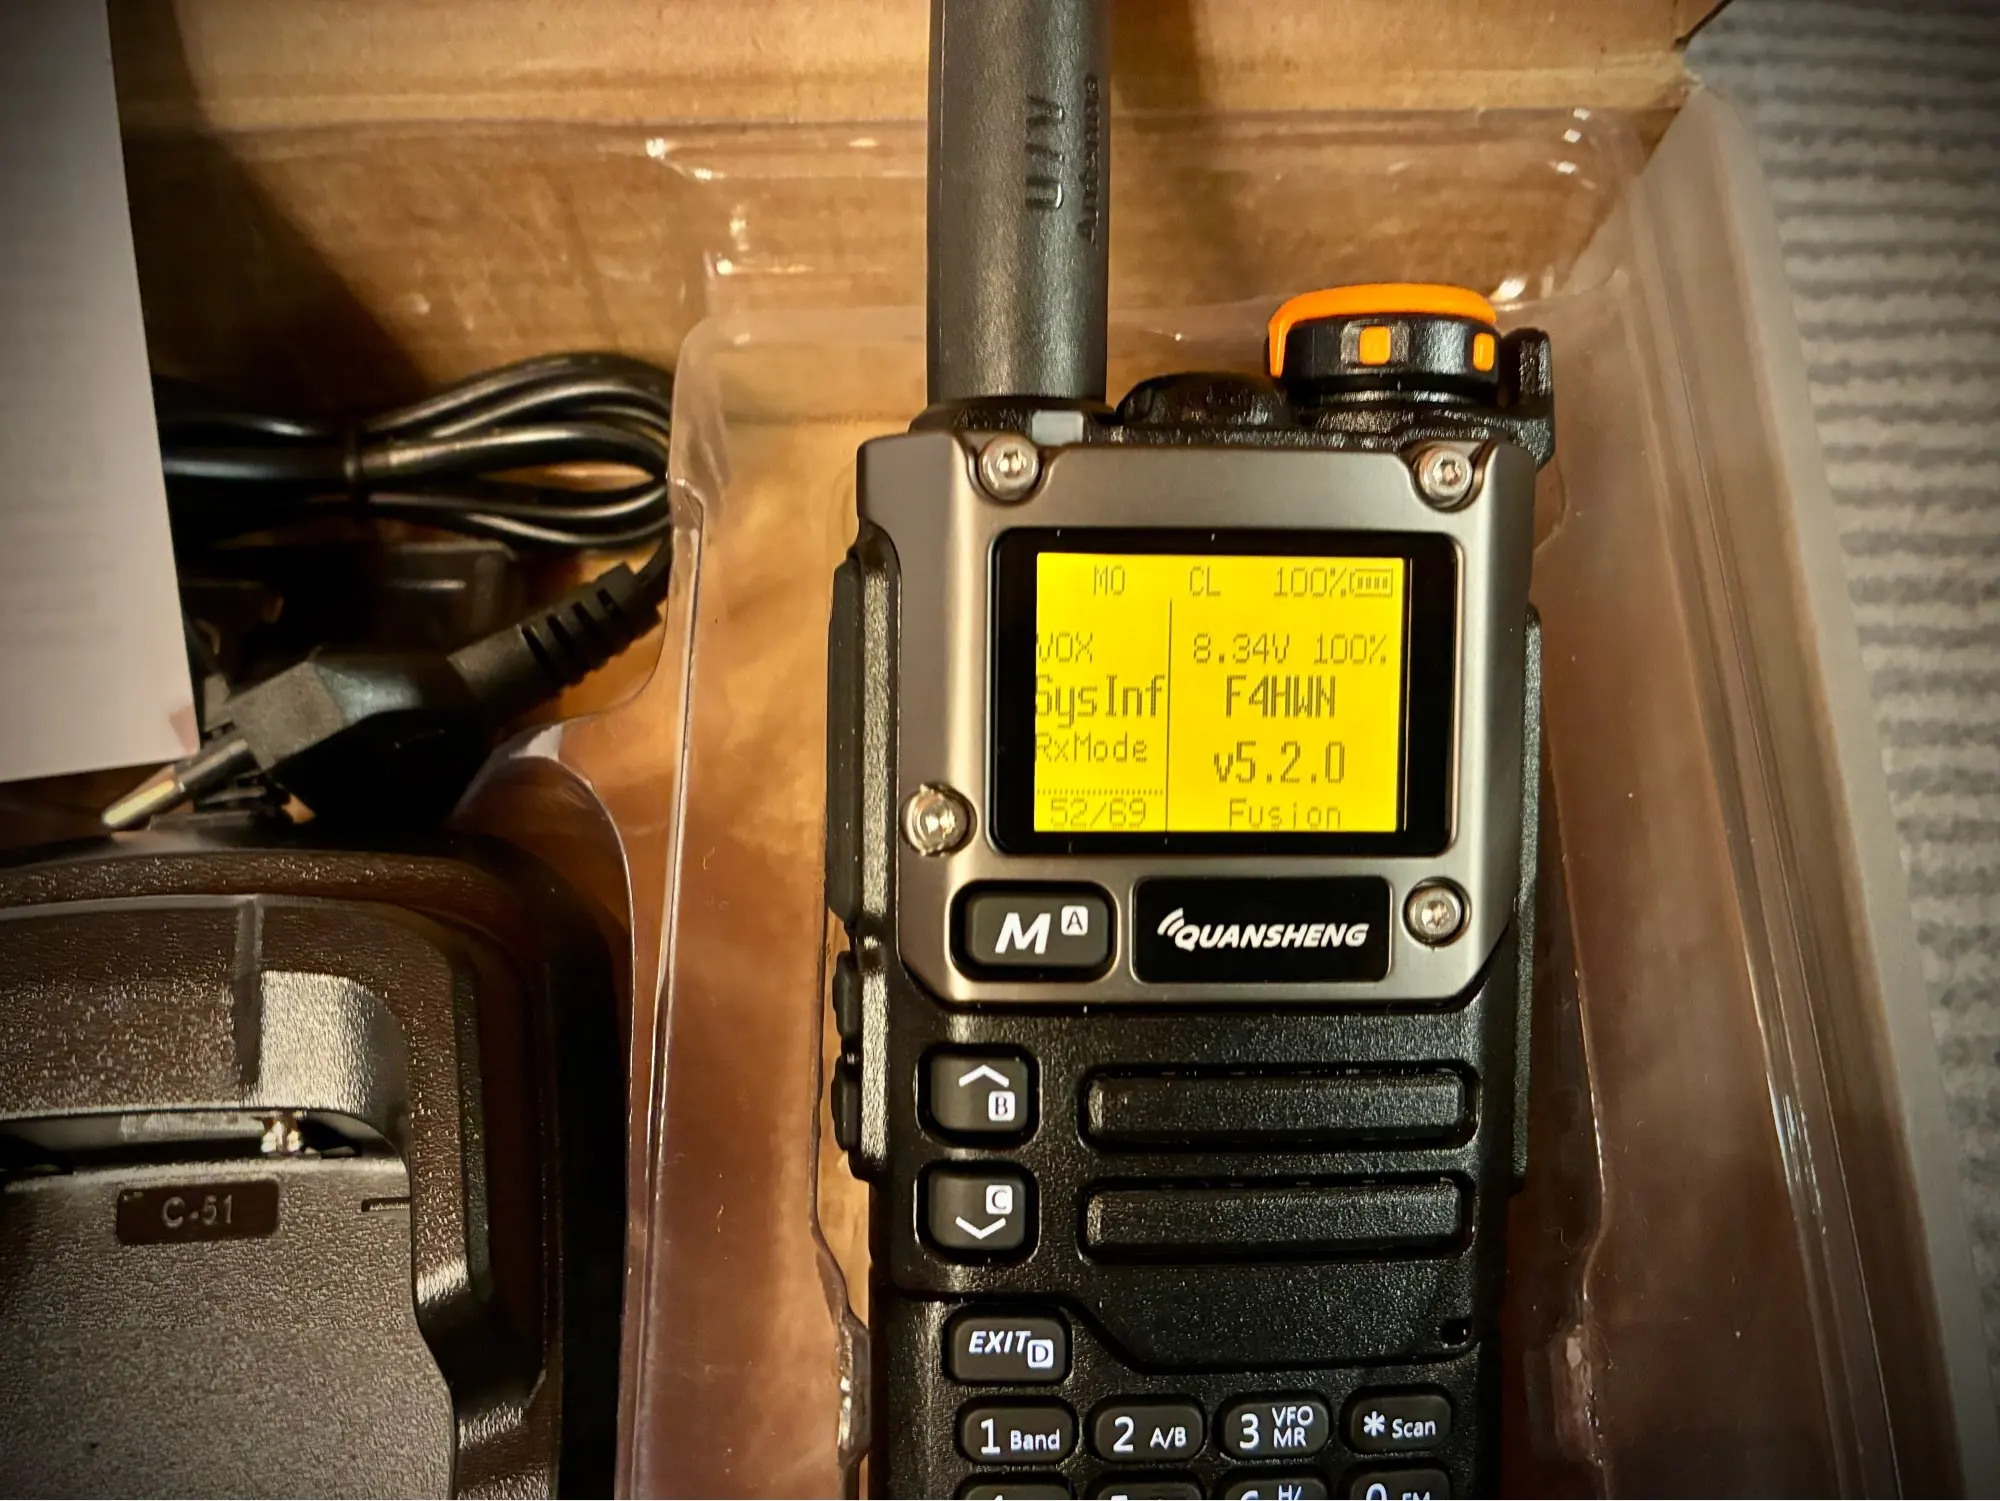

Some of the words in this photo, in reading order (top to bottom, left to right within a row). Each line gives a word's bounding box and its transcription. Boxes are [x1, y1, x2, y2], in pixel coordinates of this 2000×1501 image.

[1189, 565, 1221, 598] CL
[1273, 566, 1348, 598] 100%
[1036, 631, 1094, 664] VOX
[1193, 632, 1290, 665] 8.34V
[1313, 632, 1388, 665] 100%
[1035, 673, 1166, 729] SysInf
[1225, 674, 1337, 719] F4HWN
[1035, 730, 1148, 764] RxMode
[1213, 740, 1346, 784] v5.2.0
[1050, 797, 1147, 829] 52/69
[1228, 797, 1342, 832] Fusion
[994, 911, 1052, 955] M
[1064, 908, 1086, 933] A
[1174, 922, 1371, 952] QUANSHENG
[991, 1093, 1012, 1119] B
[989, 1187, 1009, 1212] C
[968, 1330, 1032, 1354] EXIT
[1030, 1342, 1051, 1366] D
[1239, 1412, 1260, 1450] 3
[1271, 1405, 1314, 1428] VFO
[1391, 1417, 1437, 1439] Scan
[980, 1417, 1001, 1455] 1
[1010, 1428, 1061, 1452] Band
[1112, 1416, 1135, 1453] 2
[1149, 1426, 1188, 1450] A/B
[1272, 1427, 1308, 1449] MR
